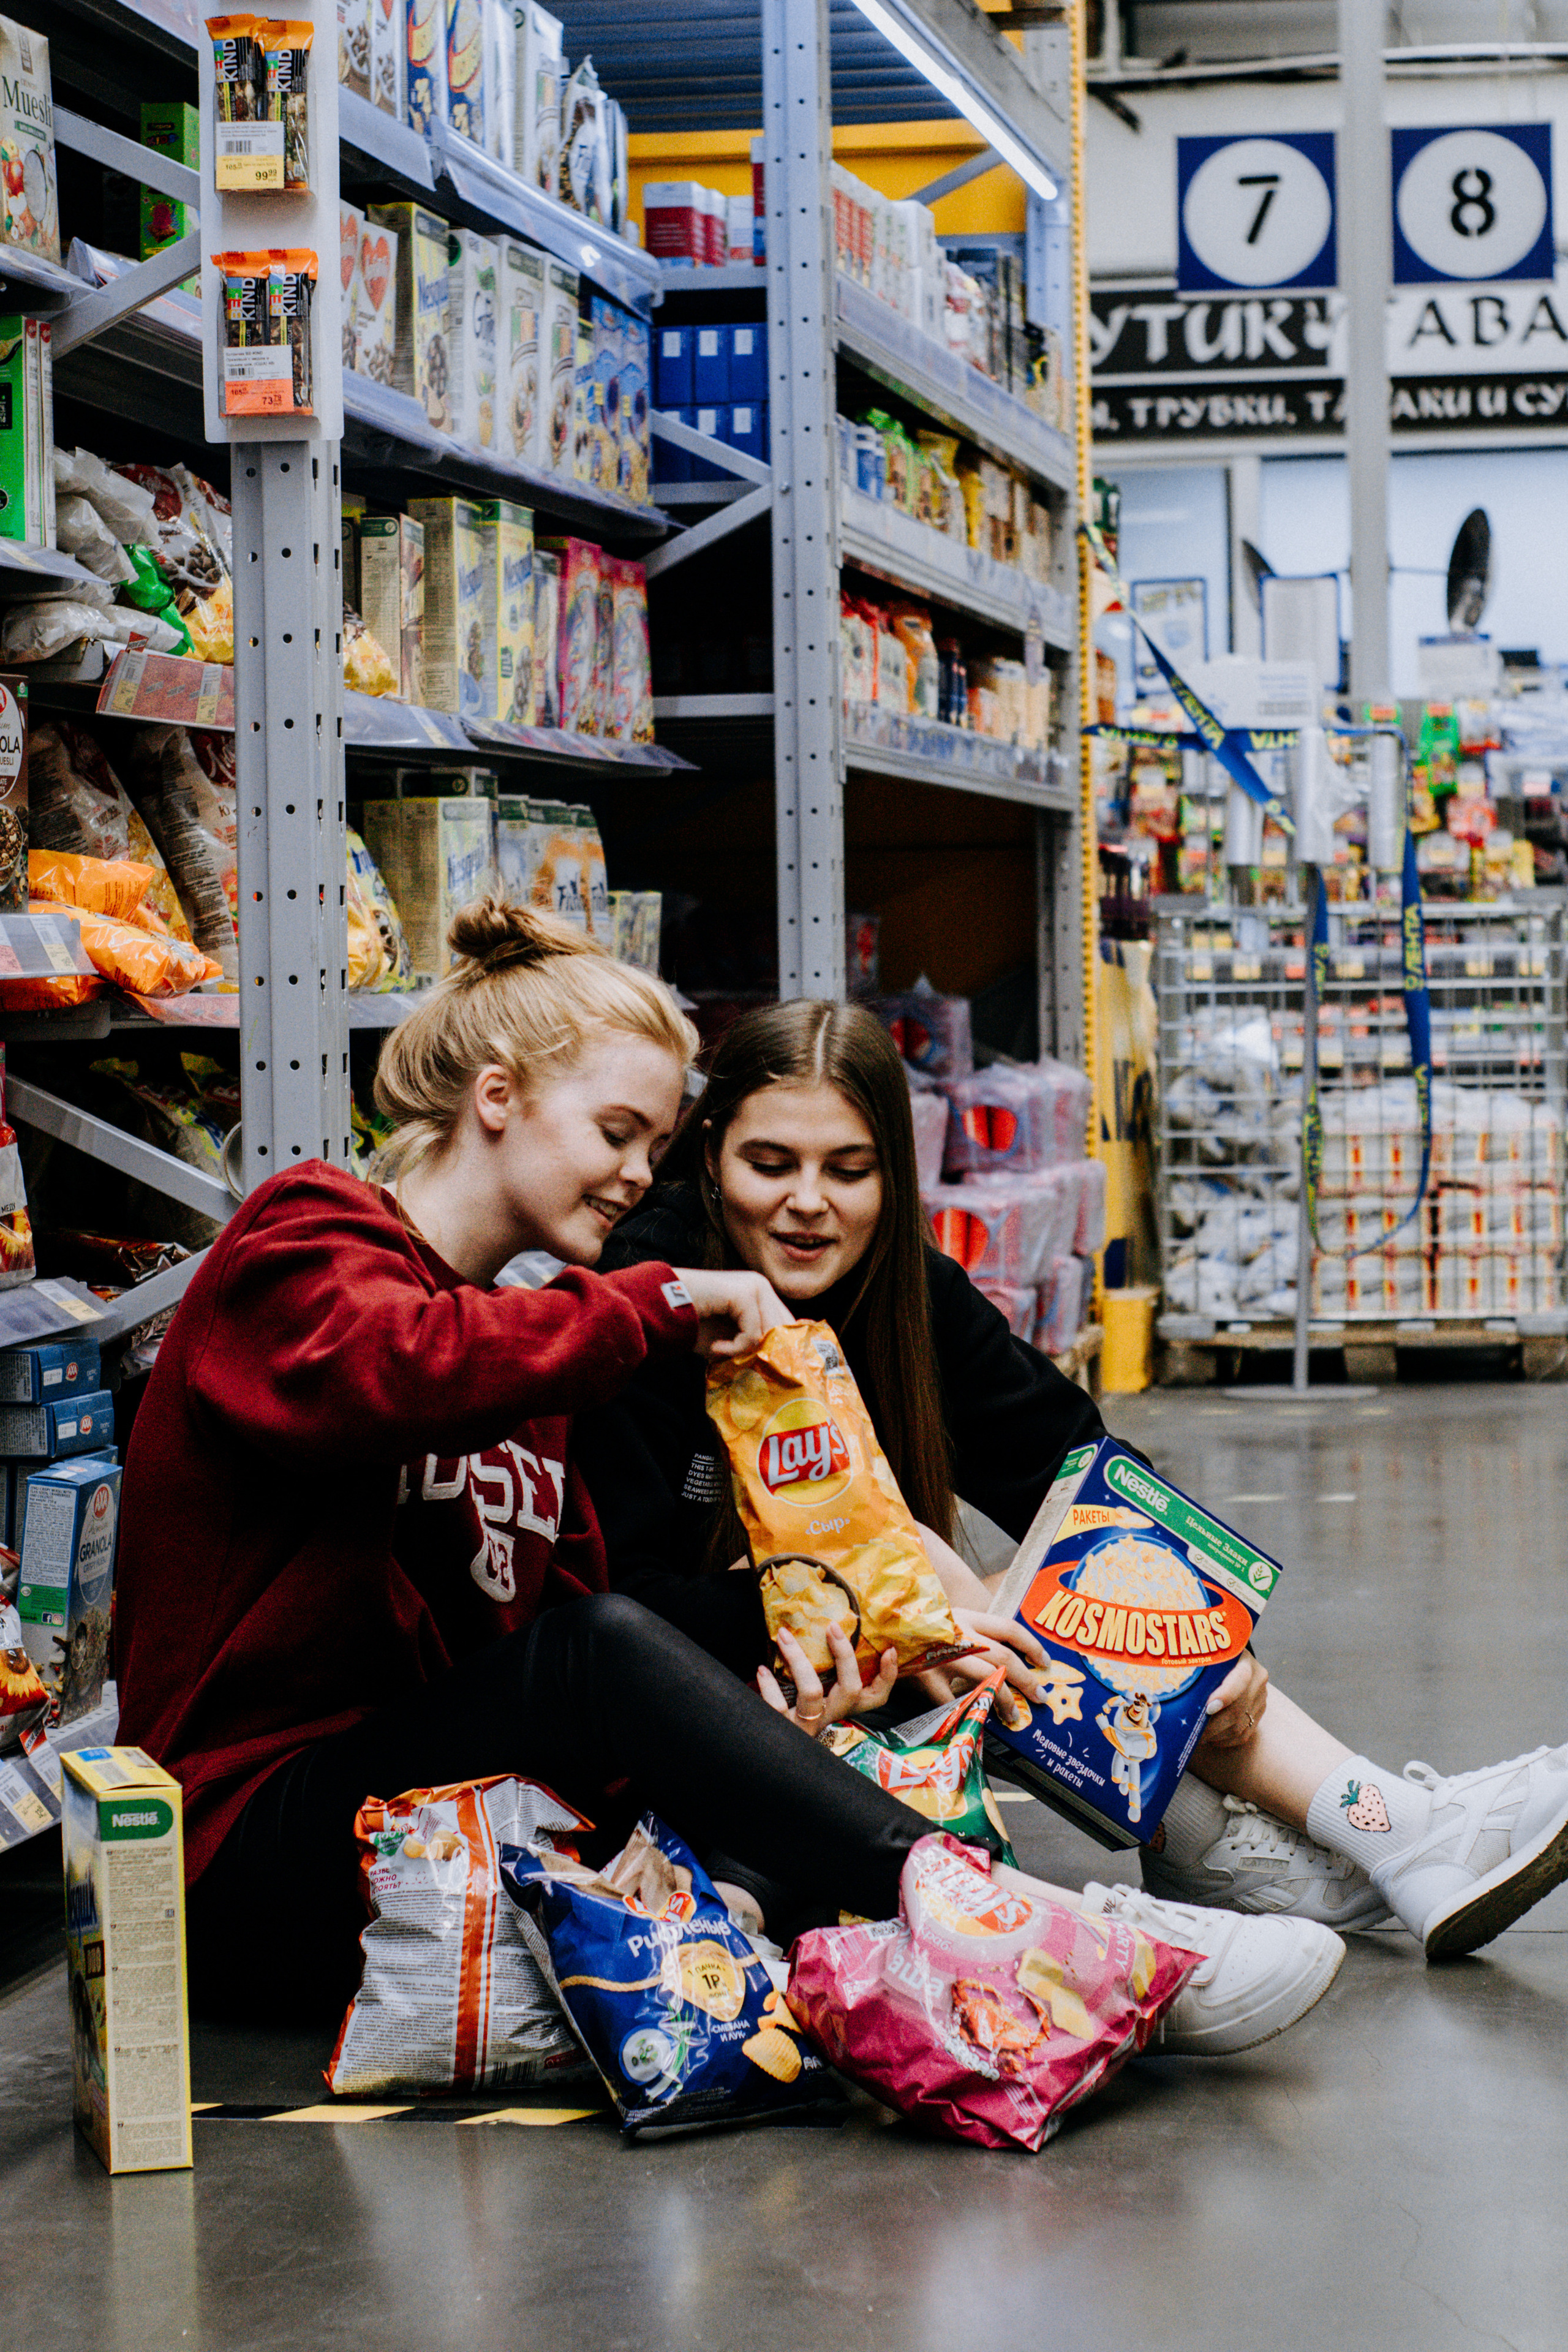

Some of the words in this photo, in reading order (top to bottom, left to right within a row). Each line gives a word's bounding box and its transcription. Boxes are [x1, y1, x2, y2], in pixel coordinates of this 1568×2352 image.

[223, 38, 238, 84] KIND
[277, 49, 292, 92] KIND
[2, 75, 51, 127] Muesli
[255, 171, 268, 181] 99
[1237, 173, 1280, 244] 7
[1449, 167, 1496, 238] 8
[242, 277, 255, 320] KIND
[283, 273, 297, 316] KIND
[262, 396, 273, 405] 73
[1, 1202, 16, 1213] МЕДУ
[67, 1364, 78, 1376] AXA
[81, 1417, 92, 1430] AXA
[768, 1417, 845, 1487] Lay's
[688, 1469, 705, 1479] DYES
[691, 1462, 705, 1471] THIS
[96, 1487, 108, 1513] AXA
[681, 1491, 697, 1501] JUST
[1073, 1509, 1110, 1526] РАКЕТЫ
[80, 1532, 112, 1562] GRANOLA
[1185, 1515, 1223, 1547] Цельные
[1222, 1542, 1249, 1567] Злаки
[1033, 1589, 1231, 1656] KOSMOSTARS
[1032, 1729, 1068, 1760] Медовые
[1065, 1753, 1106, 1787] звездочки
[1046, 1758, 1054, 1768] и
[1052, 1764, 1084, 1789] ракеты
[369, 1868, 390, 1877] РАЗВЕ
[695, 1963, 722, 1973] ПАЧКА
[720, 2033, 728, 2043] И
